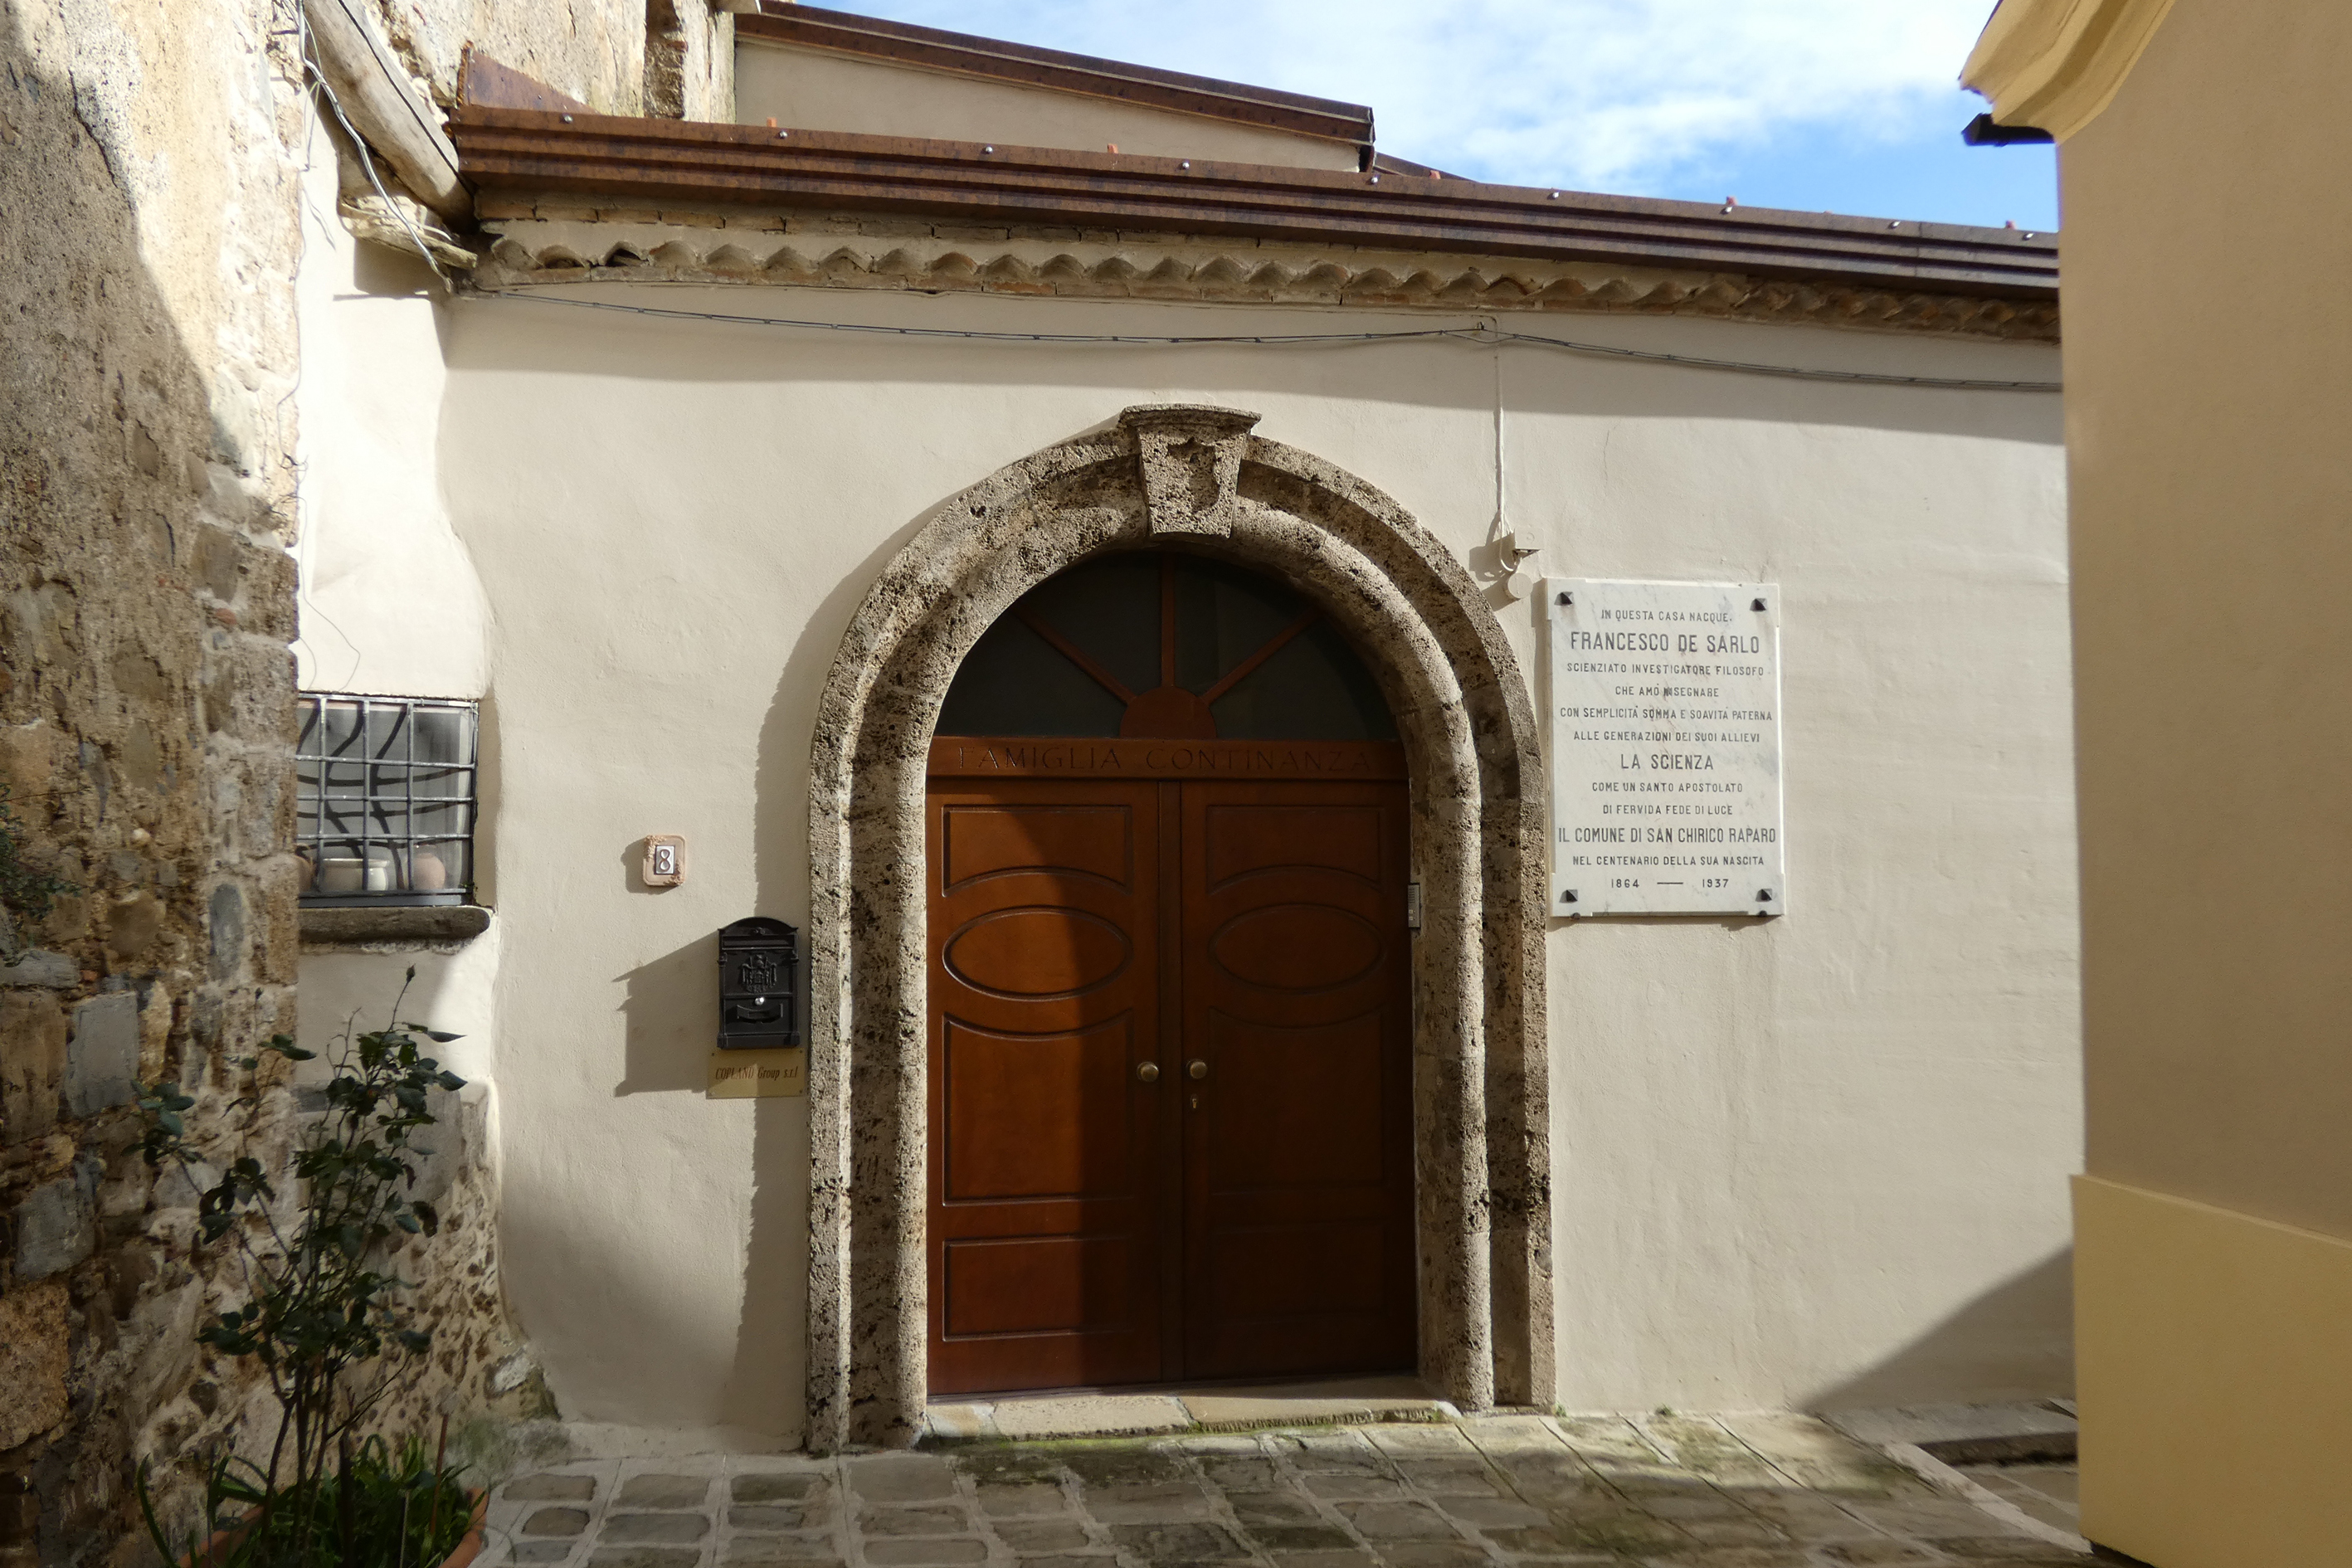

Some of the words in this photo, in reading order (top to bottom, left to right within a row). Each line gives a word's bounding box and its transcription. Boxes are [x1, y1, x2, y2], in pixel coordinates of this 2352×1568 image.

[1601, 609, 1611, 619] IN
[1615, 610, 1654, 621] QUESTA
[1658, 611, 1685, 621] CASA
[1570, 631, 1669, 651] FRANCESCO
[1678, 634, 1697, 652] DE
[1707, 635, 1759, 653] SARLO
[1567, 663, 1627, 673] SCIENZIATO
[1632, 665, 1711, 675] INVESTIGATORE
[1716, 665, 1764, 676] FILOSOFO
[1615, 686, 1634, 695] CHE
[1663, 687, 1719, 697] INSEGNARE
[1561, 708, 1579, 718] CON
[1643, 709, 1677, 719] SOMMA
[1681, 710, 1686, 719] E
[1732, 711, 1772, 721] PATERNA
[1574, 731, 1600, 740] ALLE
[1604, 732, 1671, 742] GENERAZIONI
[1676, 732, 1691, 741] DEI
[1695, 733, 1717, 742] SUOI
[1721, 733, 1759, 743] ALLIEVI
[959, 746, 1122, 770] FAMIGLIA
[1146, 747, 1371, 772] CONTINANZA
[1621, 753, 1641, 769] LA
[1651, 754, 1713, 770] SCIENZA
[1592, 782, 1619, 791] COME
[1623, 782, 1636, 791] UN
[1640, 783, 1673, 792] SANTO
[1678, 783, 1743, 792] APOSTOLATO
[1603, 805, 1611, 814] DI
[1617, 805, 1662, 815] FERVIDA
[1666, 806, 1691, 815] FEDE
[1695, 806, 1703, 815] DI
[1708, 806, 1732, 815] LUCE
[1558, 828, 1570, 842] IL
[1575, 828, 1624, 843] COMUNE
[1631, 828, 1641, 842] DI
[1648, 828, 1673, 843] SAN
[1678, 828, 1723, 843] CHIRICO
[1729, 829, 1775, 843] RAPARO
[659, 849, 671, 872] 8
[1573, 856, 1591, 865] NEL
[1596, 856, 1659, 865] CENTENARIO
[1663, 856, 1696, 865] DELLA
[1701, 857, 1718, 865] SUA
[1723, 857, 1764, 865] NASCITA
[1611, 879, 1640, 888] 1864
[1702, 879, 1729, 888] 1937
[715, 1067, 754, 1079] COPLAND
[758, 1066, 780, 1081] Group
